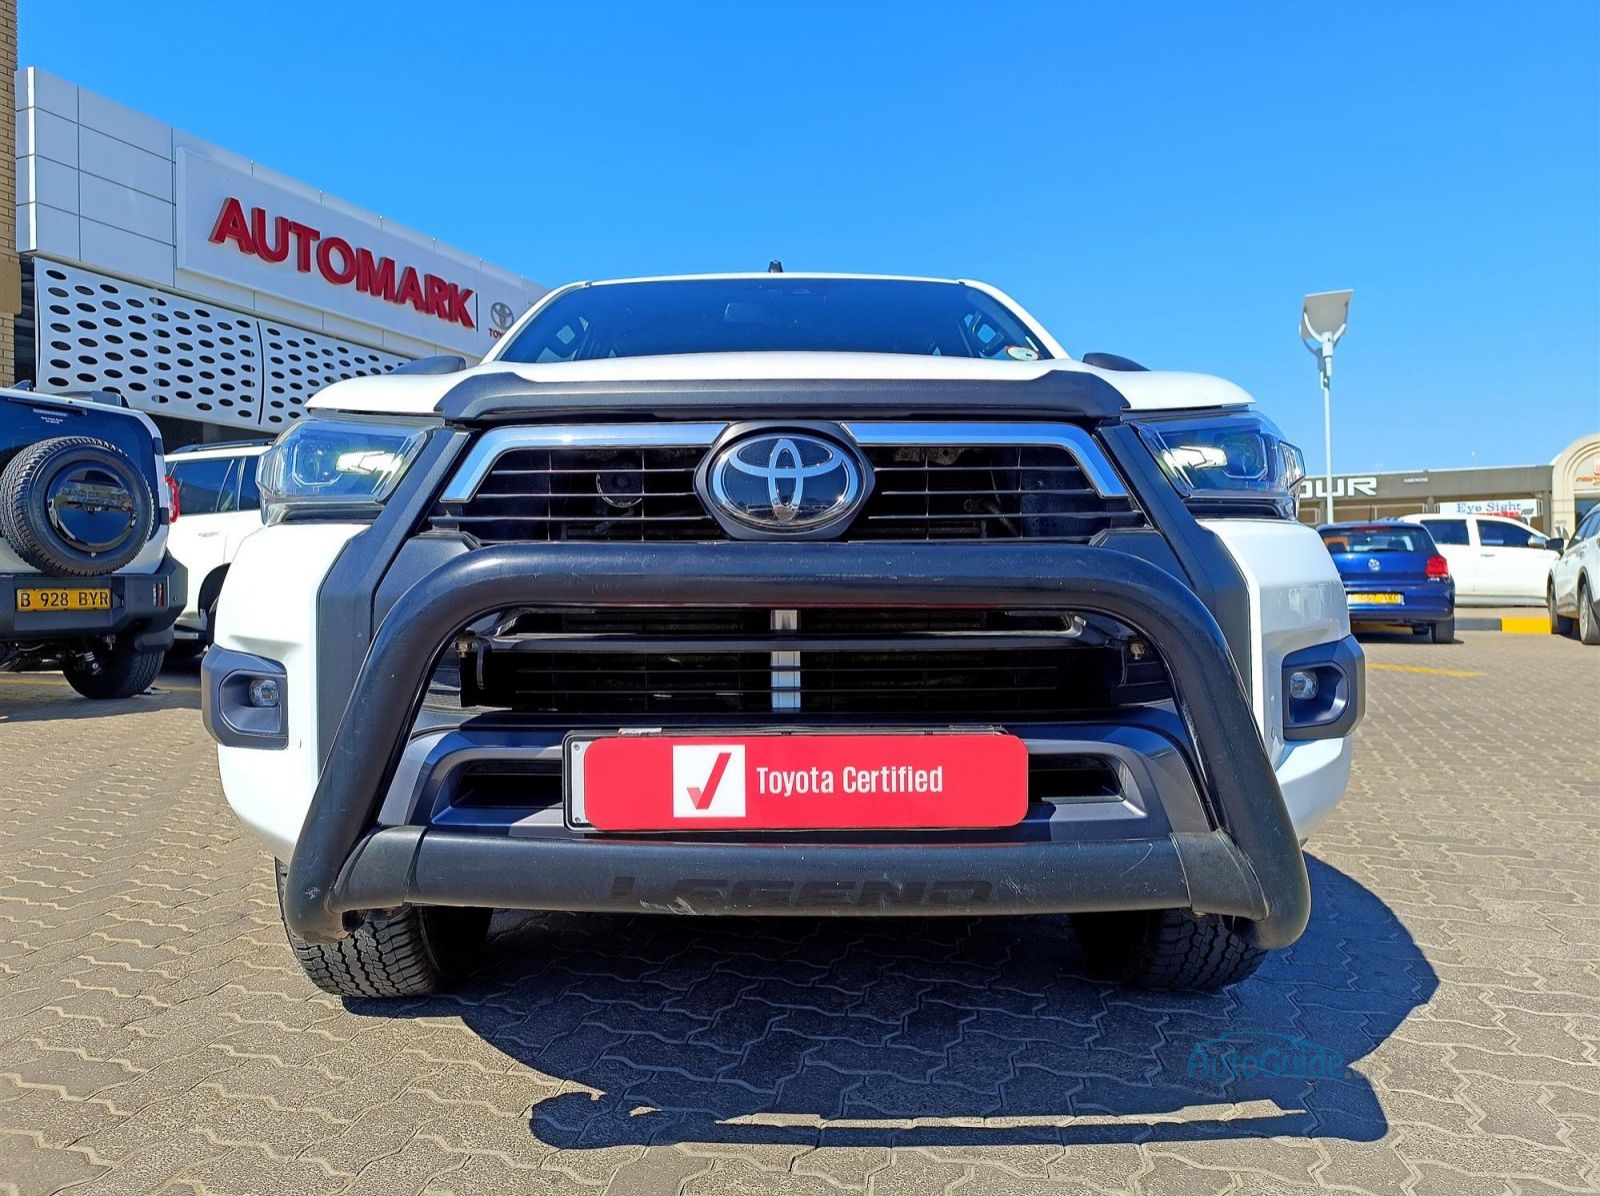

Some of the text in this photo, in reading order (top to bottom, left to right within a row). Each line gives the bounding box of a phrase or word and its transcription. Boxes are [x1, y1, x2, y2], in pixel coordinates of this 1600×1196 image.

[208, 197, 475, 329] AUTOMARK
[1457, 501, 1521, 514] Eye Sight
[20, 591, 109, 607] B 928 BYR
[756, 766, 943, 797] Toyota Certified
